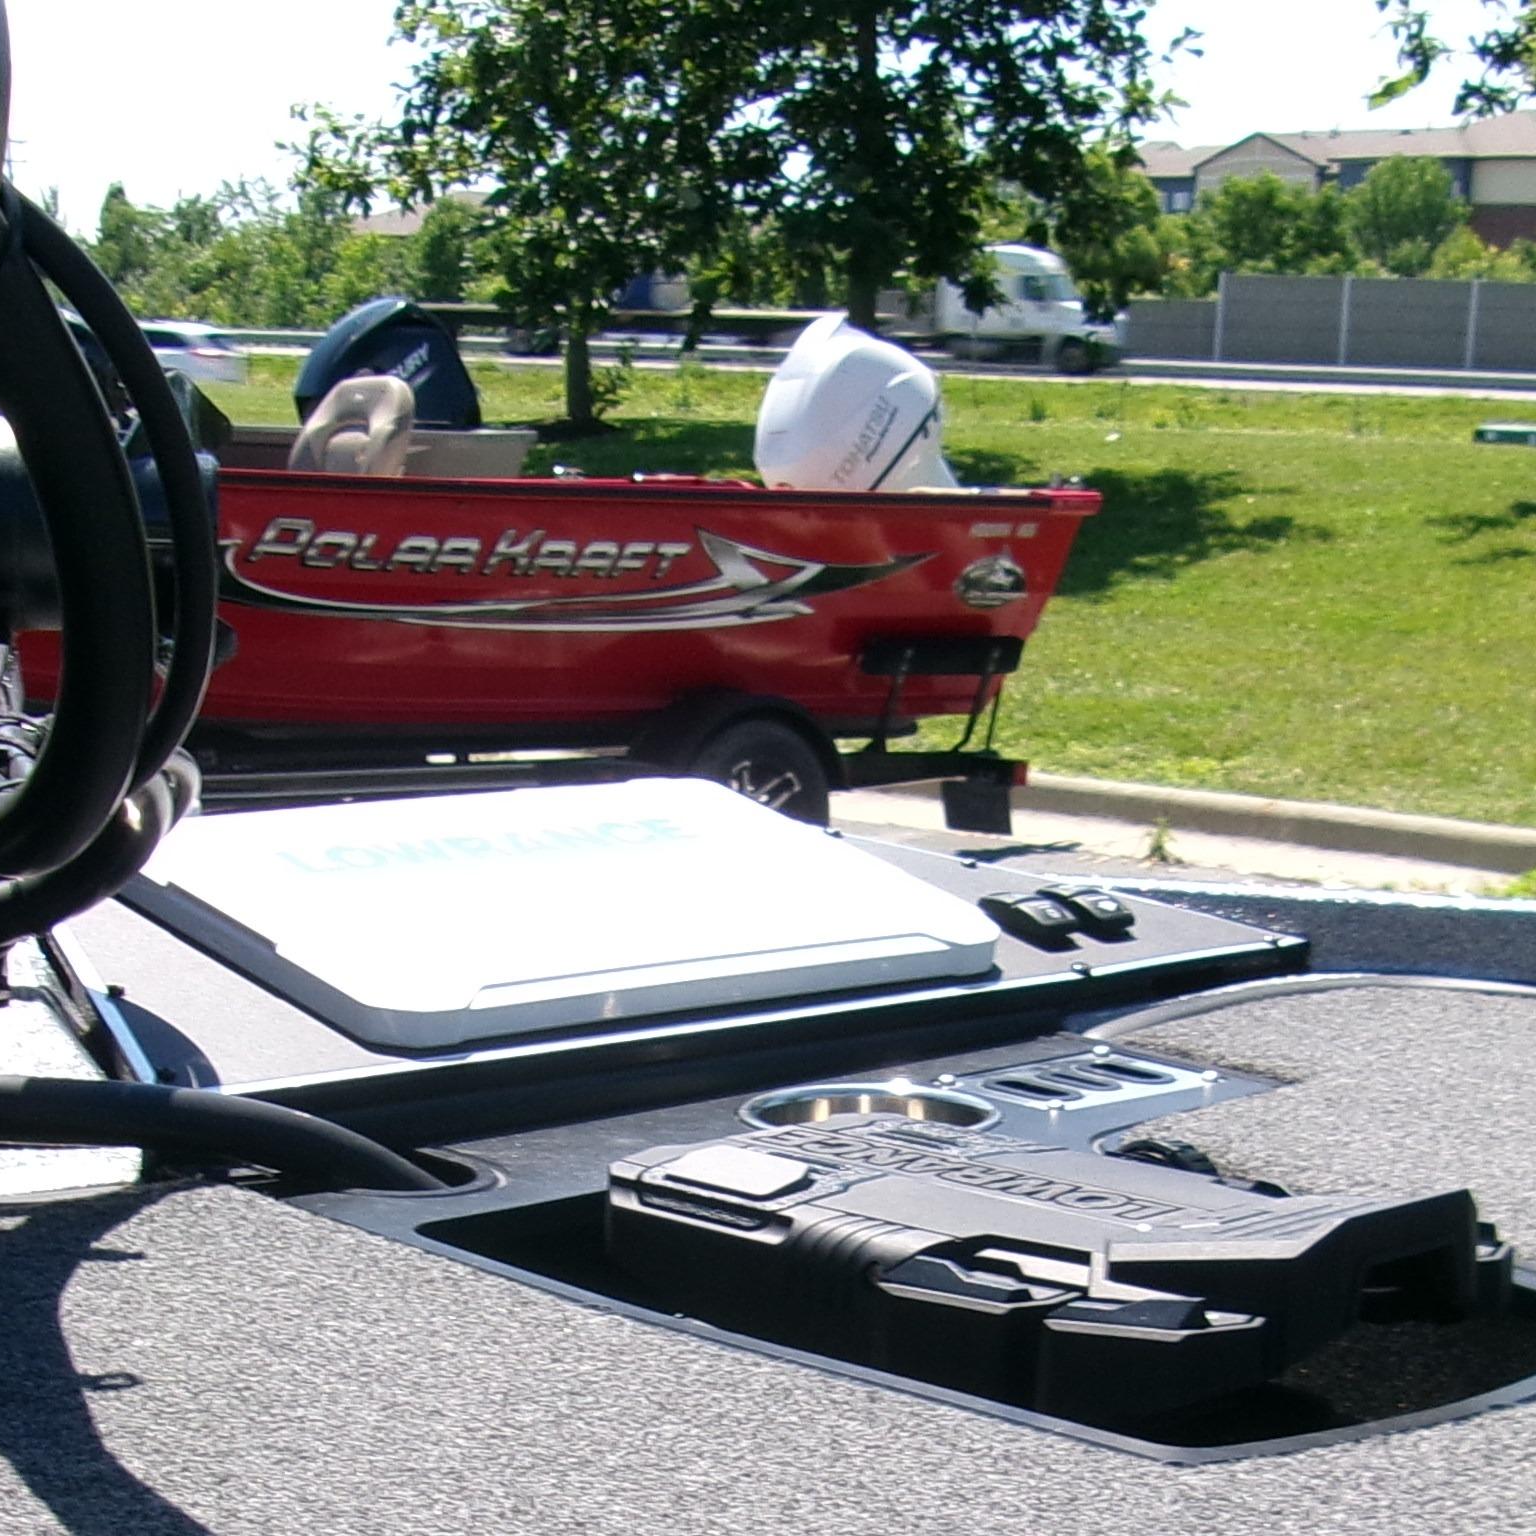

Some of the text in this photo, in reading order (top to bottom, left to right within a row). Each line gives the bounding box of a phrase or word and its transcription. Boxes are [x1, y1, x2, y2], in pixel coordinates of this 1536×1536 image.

[249, 517, 692, 579] POLAR KRAFT
[275, 818, 699, 873] LOWRANCE
[760, 1130, 1181, 1220] LOWRANCE
